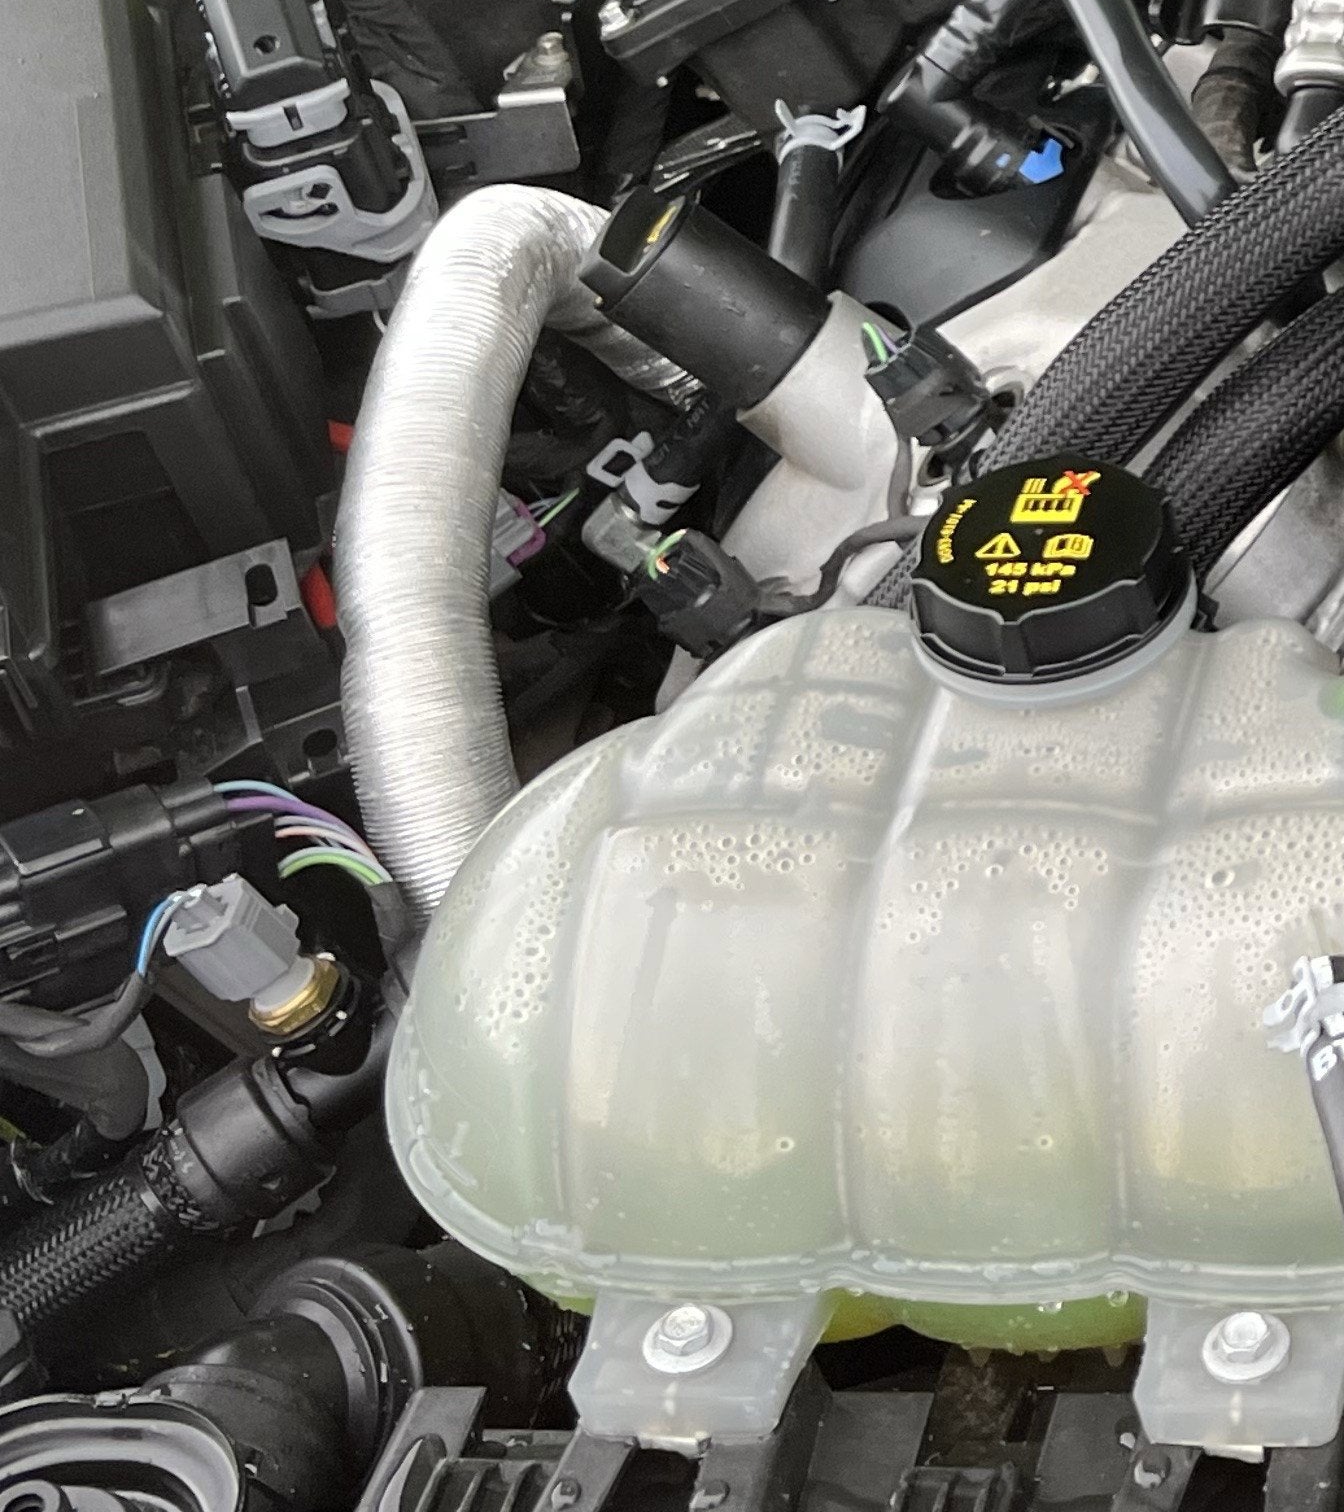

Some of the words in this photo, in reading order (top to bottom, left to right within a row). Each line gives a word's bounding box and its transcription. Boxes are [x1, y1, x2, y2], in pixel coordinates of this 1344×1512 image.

[984, 562, 1028, 577] 145
[1030, 562, 1077, 577] kPa
[988, 579, 1019, 595] 21
[1022, 579, 1062, 596] psi
